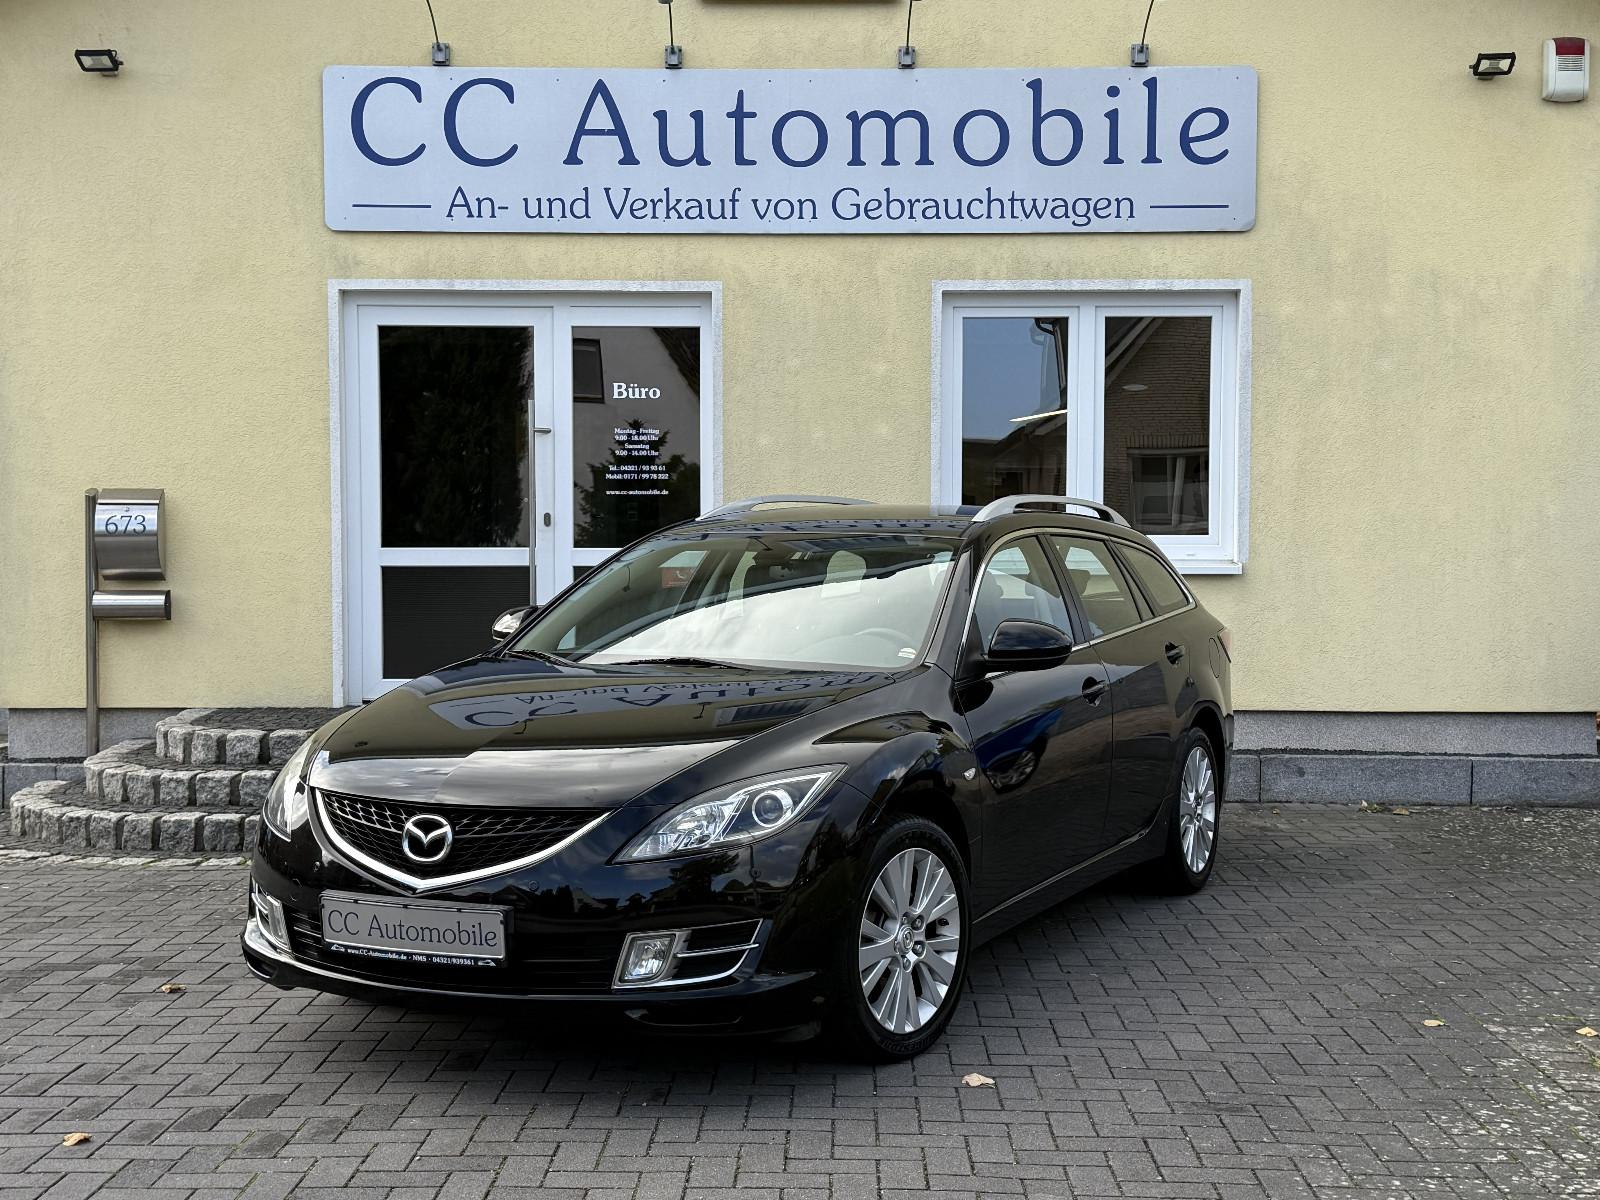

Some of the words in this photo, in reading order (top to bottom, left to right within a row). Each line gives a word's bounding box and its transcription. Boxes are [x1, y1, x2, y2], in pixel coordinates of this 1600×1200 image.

[351, 77, 519, 167] CC
[563, 77, 1230, 167] Automobile
[446, 186, 508, 219] An-
[523, 187, 591, 219] und
[604, 187, 742, 220] Verkauf
[752, 198, 818, 220] von
[831, 187, 1135, 227] Gebrauchtwagen
[612, 382, 661, 399] Büro
[614, 427, 636, 435] Montag
[640, 427, 660, 435] Freitag
[105, 514, 147, 535] 673
[327, 909, 360, 936] CC
[367, 913, 498, 947] Automobile
[347, 948, 407, 960] www.CC-Automobile.de
[412, 954, 427, 962] NMS
